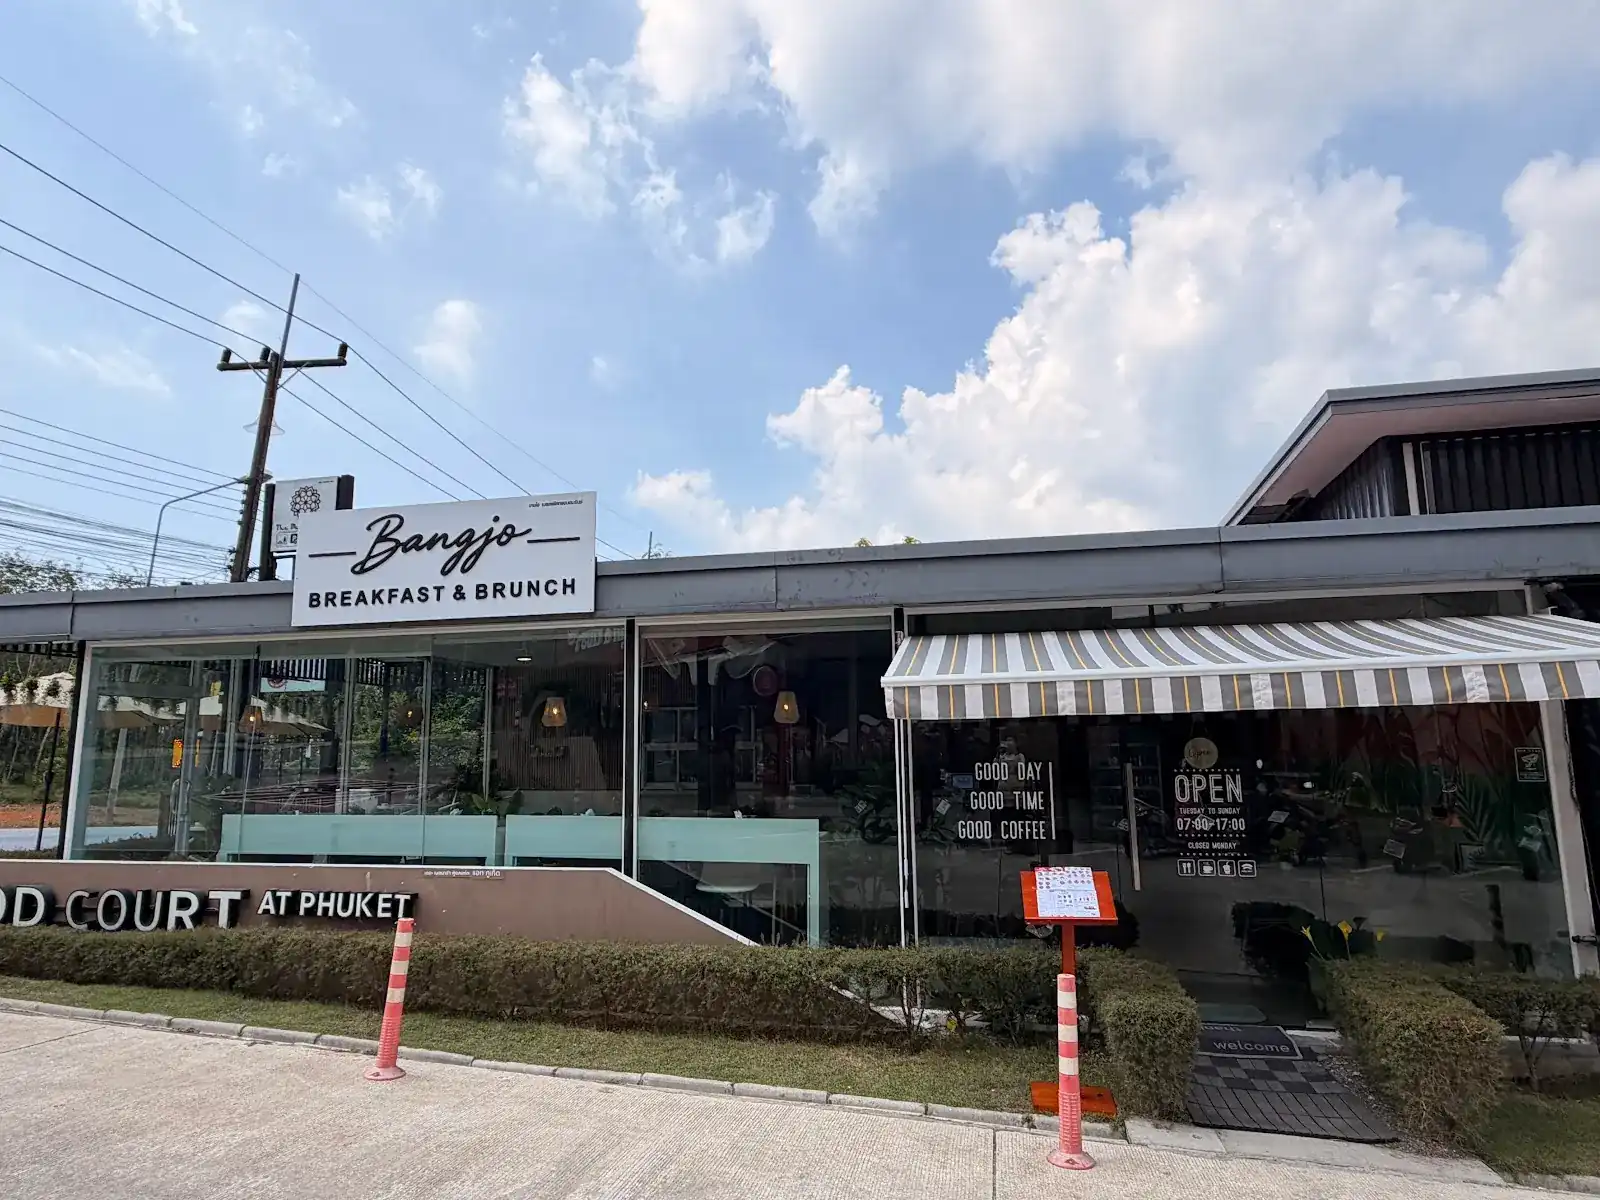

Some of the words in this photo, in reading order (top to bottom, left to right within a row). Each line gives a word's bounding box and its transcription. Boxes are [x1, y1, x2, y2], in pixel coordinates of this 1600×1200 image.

[350, 513, 533, 577] Bangjo
[308, 585, 445, 609] BREAKFAST
[452, 584, 466, 601] &
[475, 578, 577, 600] BRUNCH
[975, 762, 1009, 781] GOOD
[1017, 761, 1042, 781] DAY
[1174, 774, 1244, 803] OPEN
[970, 791, 1004, 810] GOOD
[1013, 791, 1045, 811] TIME
[1179, 807, 1205, 815] TUESDAY
[1208, 807, 1216, 815] TO
[1217, 807, 1240, 815] SUNDAY
[958, 820, 992, 840] GOOD
[1001, 820, 1047, 840] COFFEE
[1187, 842, 1210, 850] CLOSED
[1211, 842, 1237, 850] MONDAY
[0, 886, 46, 927] D
[65, 889, 241, 932] COURT
[257, 890, 292, 915] AT
[299, 891, 411, 918] PHUKET
[1213, 1040, 1290, 1053] welcome
